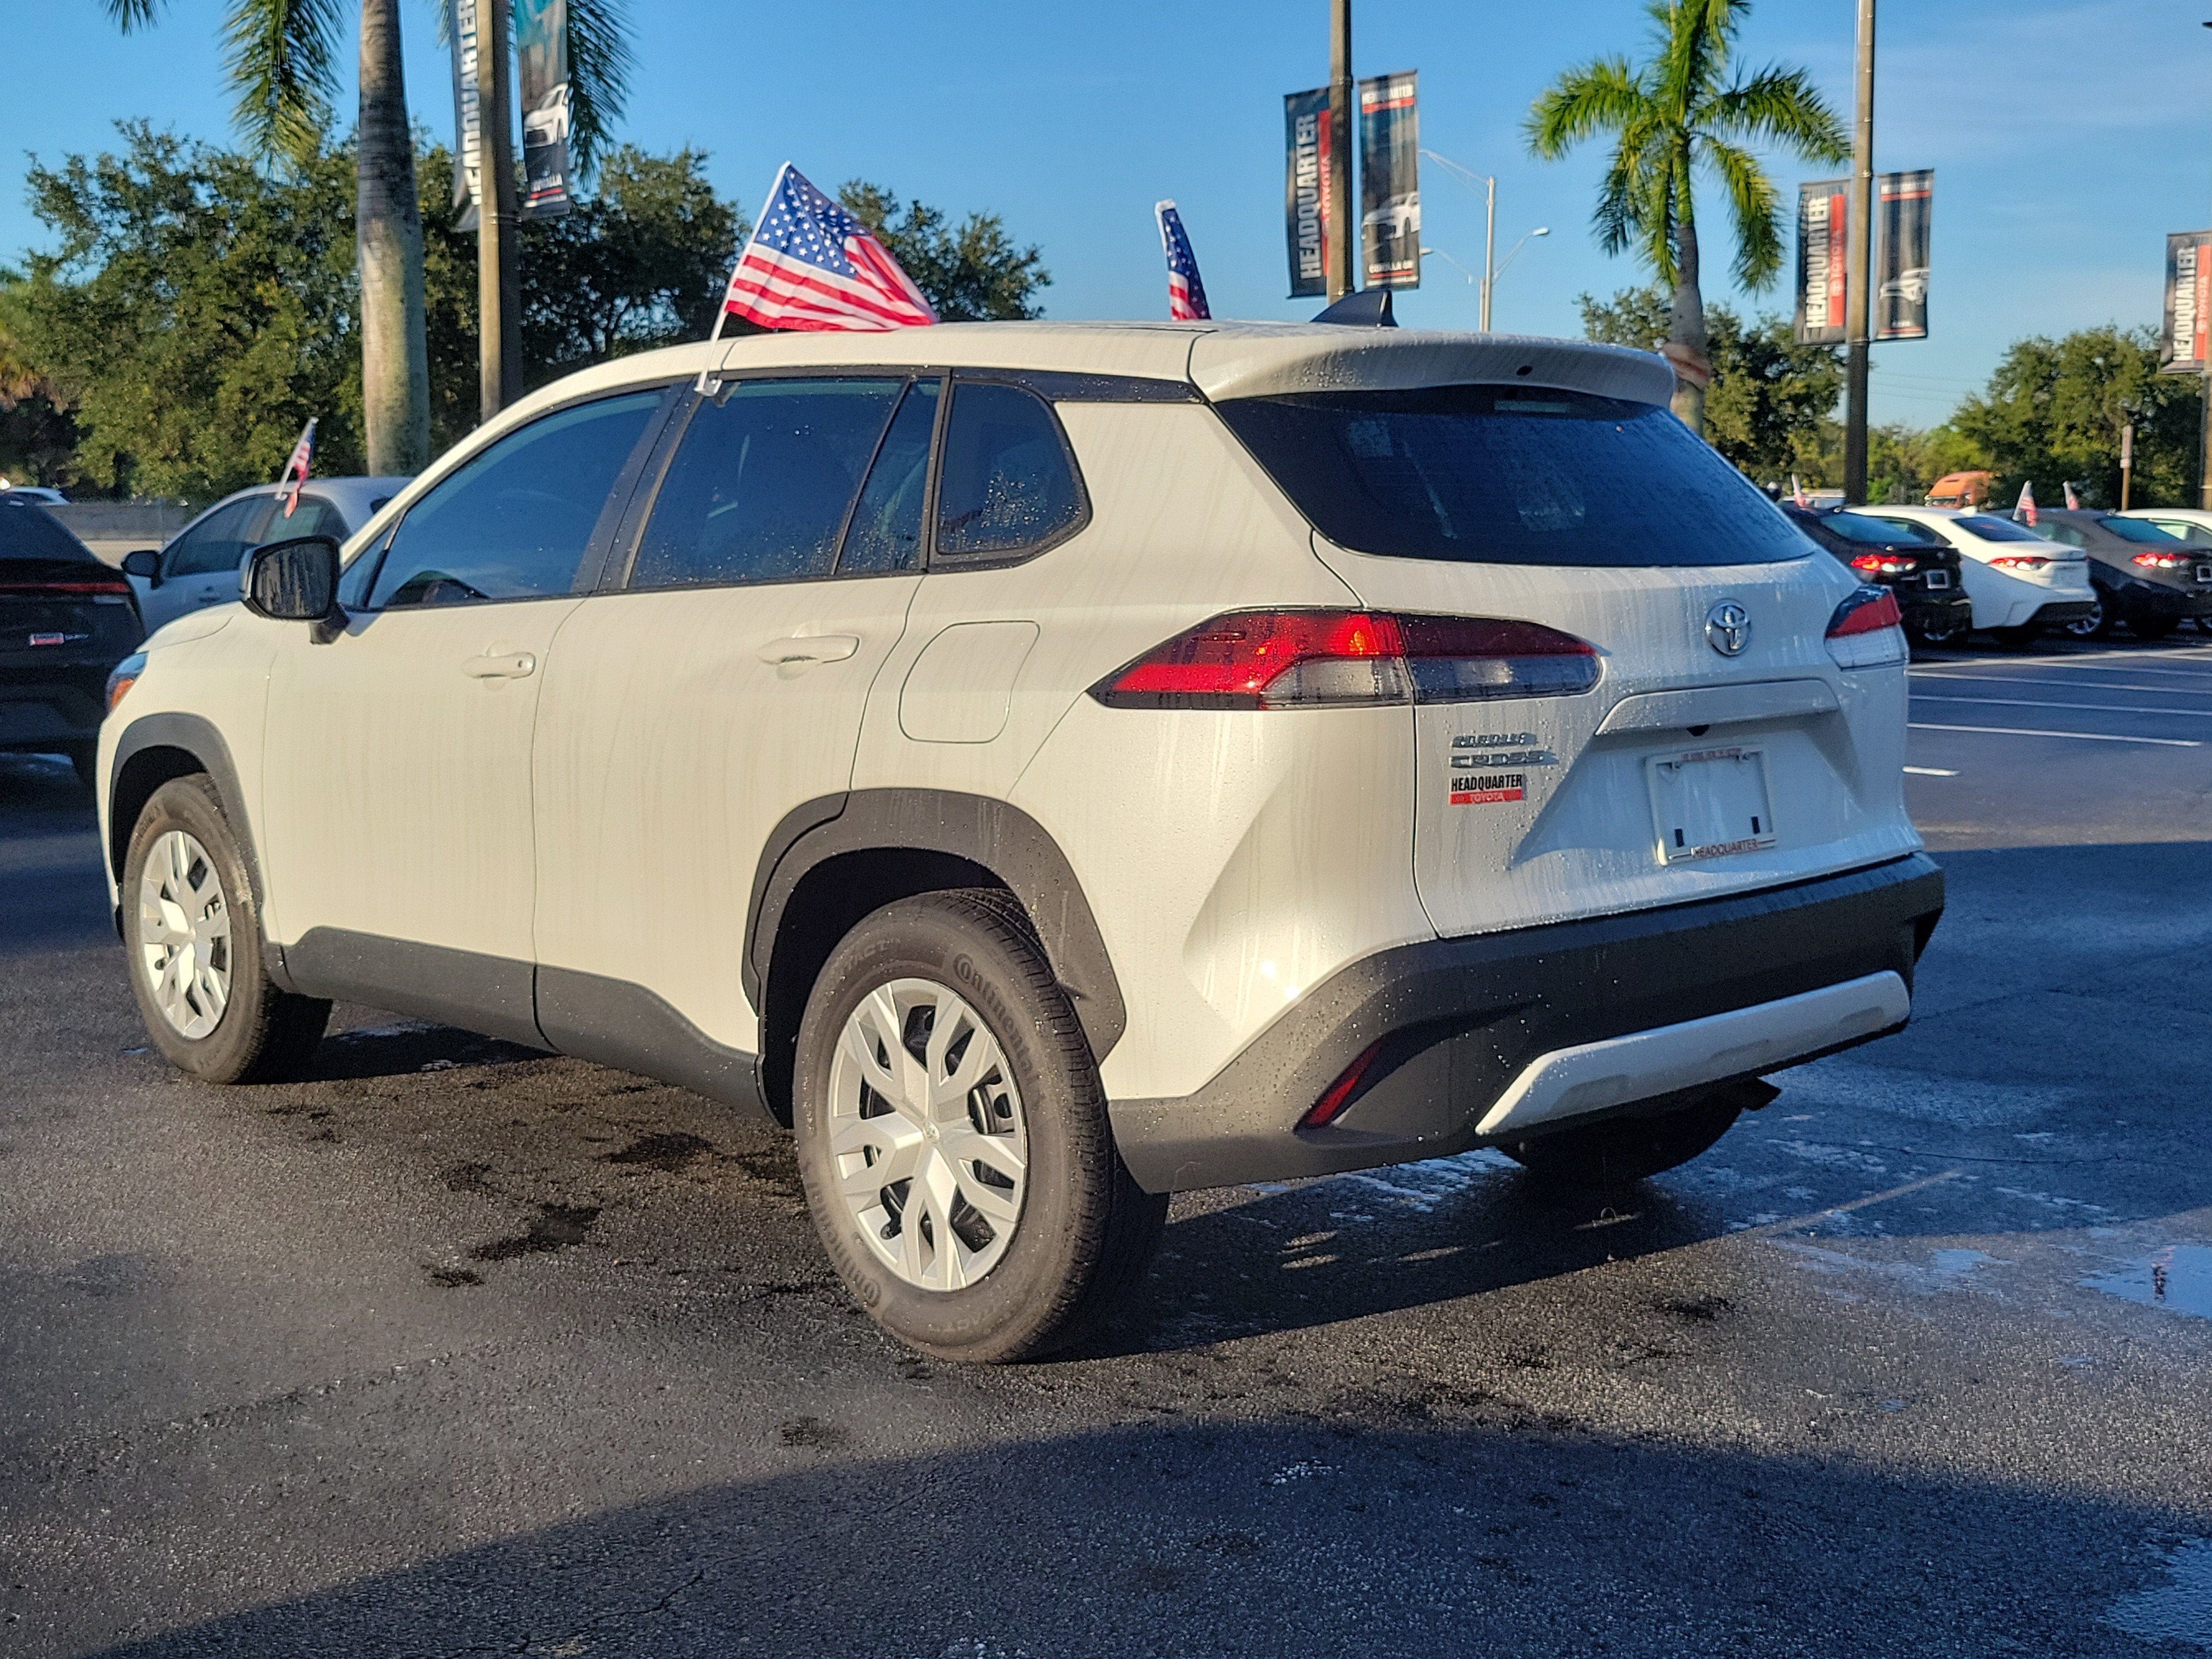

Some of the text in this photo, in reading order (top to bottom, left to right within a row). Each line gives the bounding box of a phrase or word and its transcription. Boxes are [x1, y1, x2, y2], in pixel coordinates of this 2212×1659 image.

[1295, 113, 1321, 279] HEADQUARTER
[1805, 196, 1829, 328] HEADQUARTER
[2172, 247, 2196, 361] HEADQUARTER
[1451, 774, 1522, 792] HEADQUARTER
[1470, 792, 1505, 803] TOYOTA
